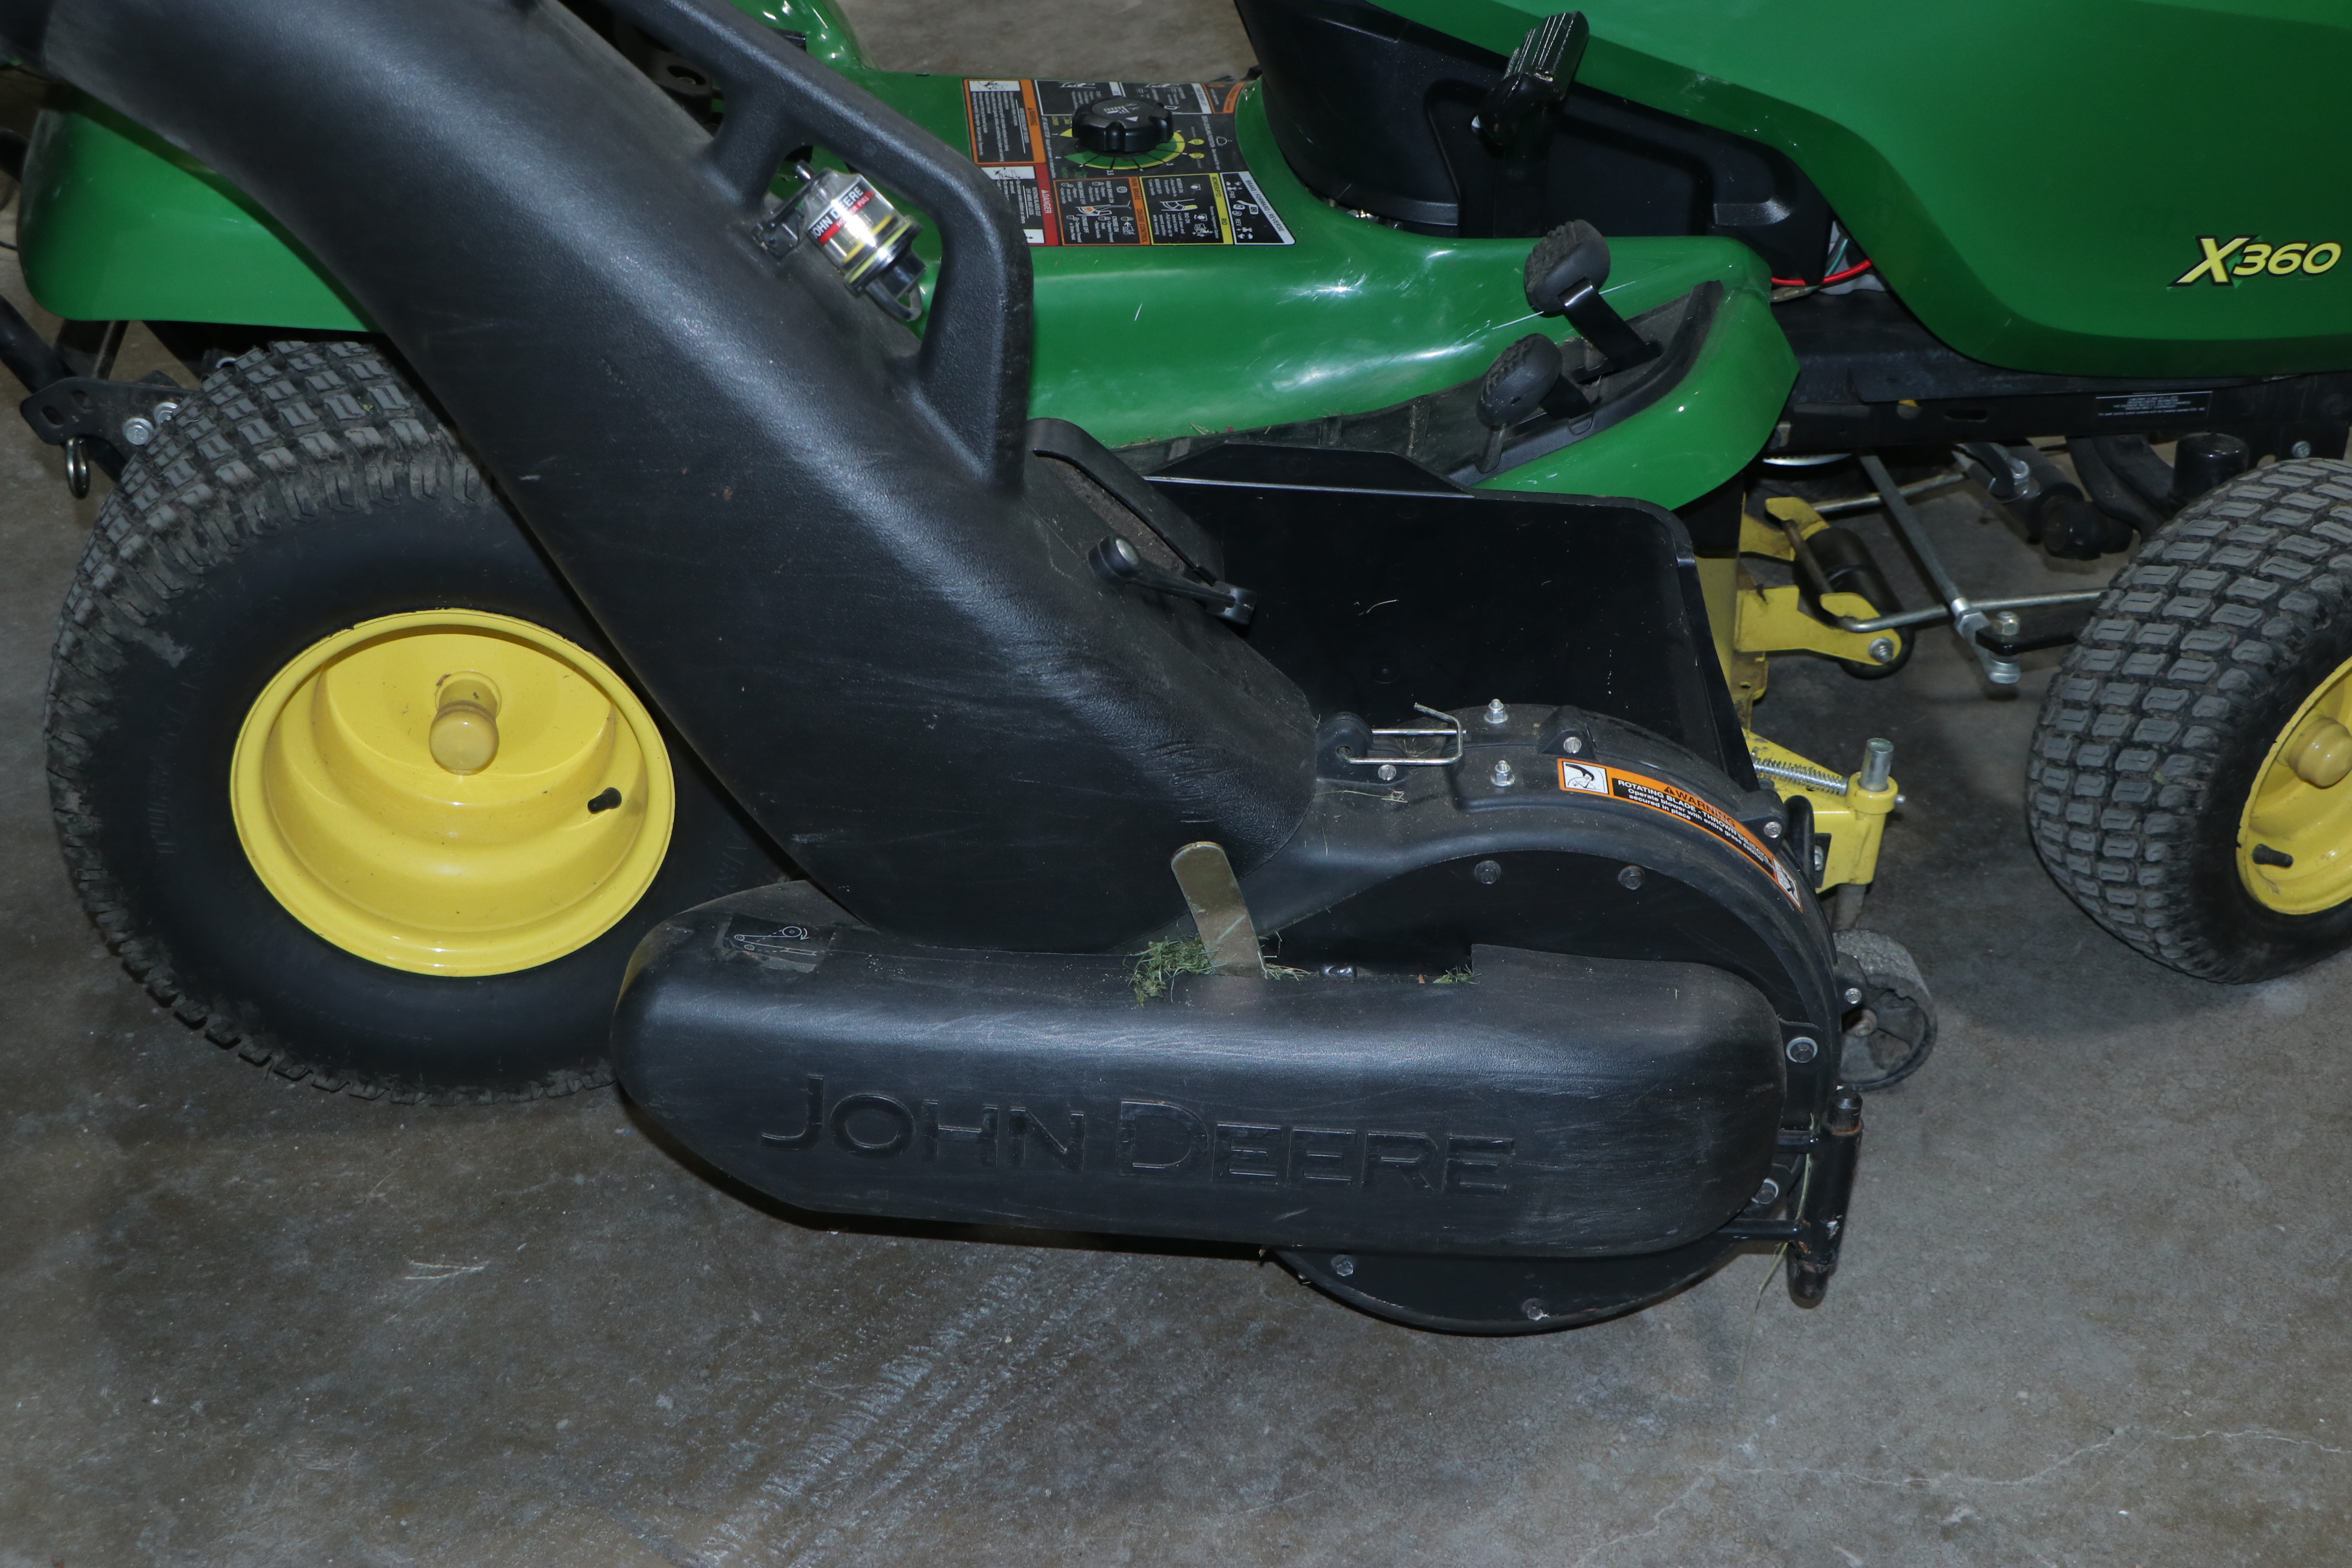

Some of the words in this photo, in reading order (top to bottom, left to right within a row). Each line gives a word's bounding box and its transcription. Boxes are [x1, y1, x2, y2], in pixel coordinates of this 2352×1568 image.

[837, 205, 858, 228] HOER
[858, 197, 870, 209] FULL
[1043, 194, 1052, 214] DANGER
[1246, 180, 1258, 191] BRAKE
[1255, 194, 1270, 211] FORWARD
[1267, 214, 1285, 232] REVERSE
[2171, 236, 2343, 285] X360
[1618, 780, 1664, 798] ROTATING
[1666, 793, 1697, 812] BLADE
[1702, 811, 1737, 837] THROWN
[1628, 788, 1659, 802] Operate
[1661, 797, 1685, 812] blower
[1687, 809, 1703, 821] with
[1704, 818, 1723, 832] entire
[1724, 828, 1742, 844] grass
[1743, 842, 1765, 863] catcher
[1629, 794, 1660, 808] secured
[1671, 808, 1691, 821] place
[1675, 789, 1736, 828] WARNING
[760, 1073, 1086, 1174] JOHN
[1116, 1098, 1515, 1194] DEERE
